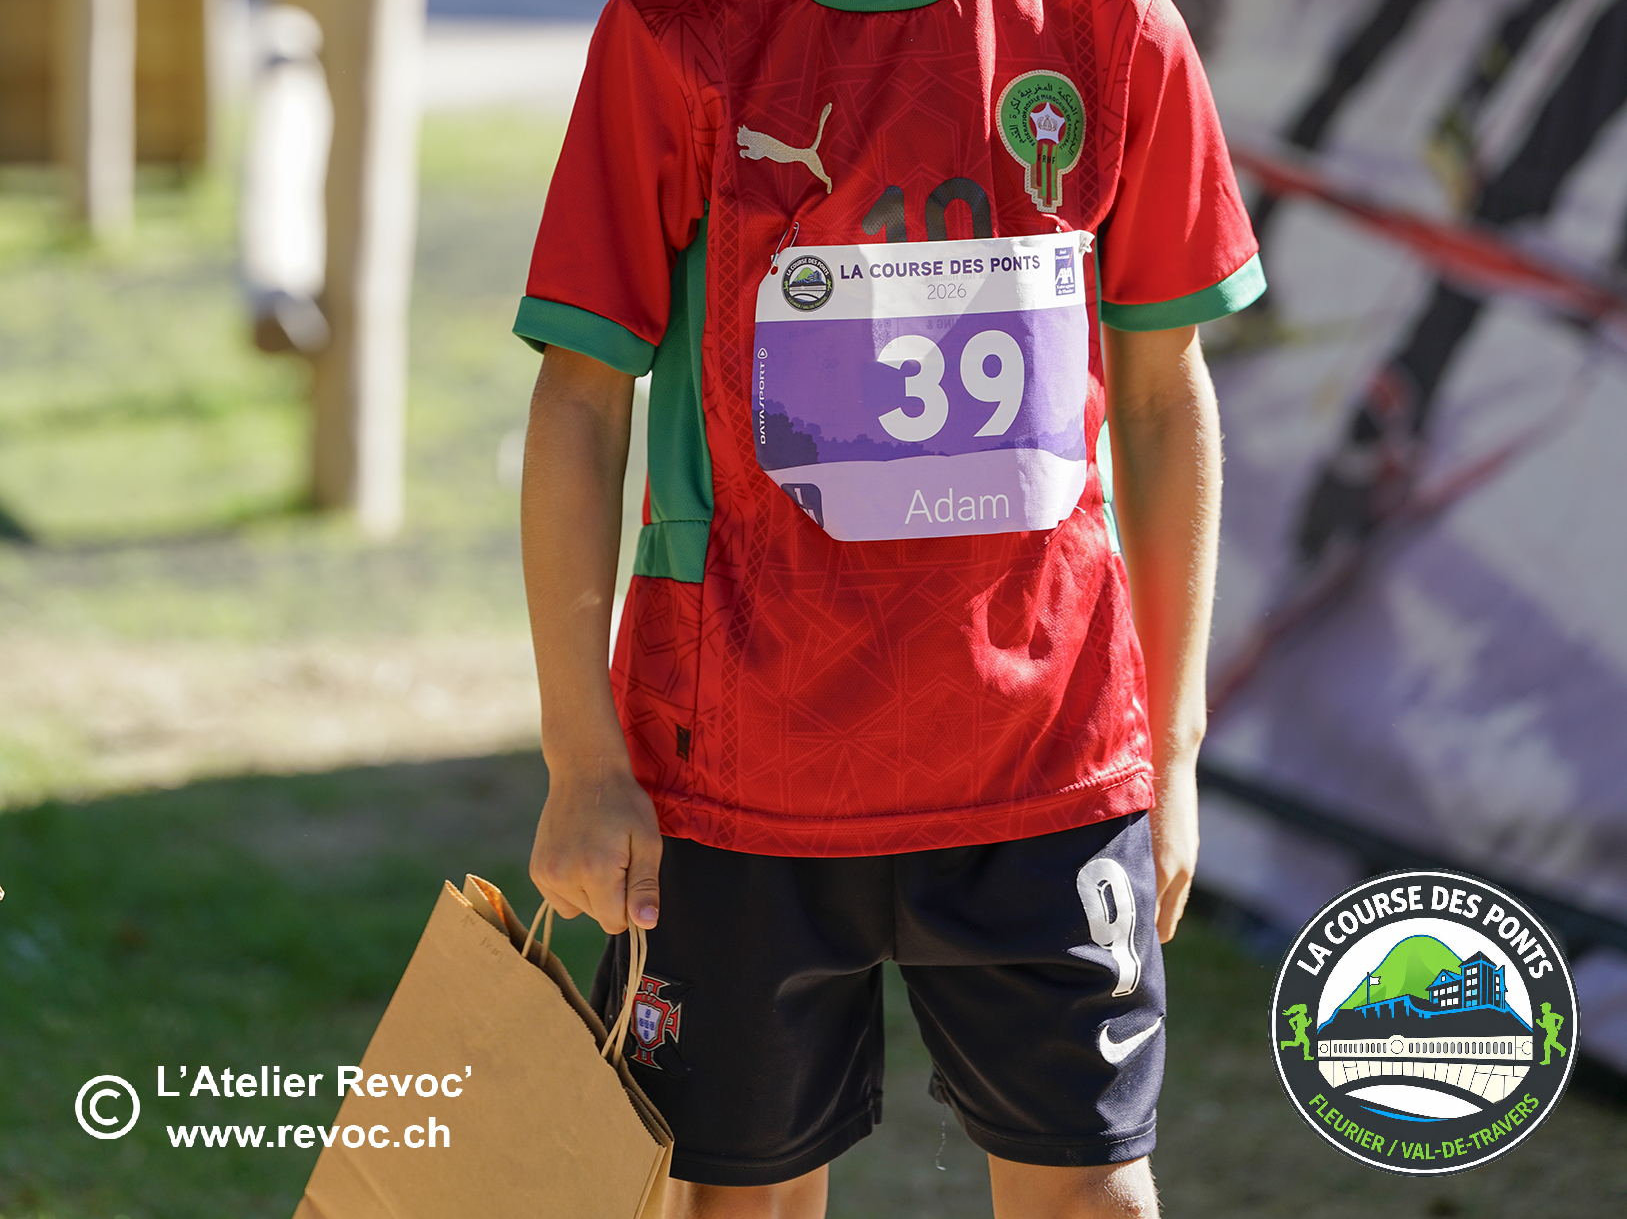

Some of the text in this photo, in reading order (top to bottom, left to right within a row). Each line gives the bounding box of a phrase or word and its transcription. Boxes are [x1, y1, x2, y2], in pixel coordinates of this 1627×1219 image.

[840, 255, 1041, 280] LA COURSE DES PONTS
[927, 283, 967, 300] 2026
[758, 361, 766, 445] DATASPORT
[877, 329, 1025, 442] 39
[904, 487, 1010, 525] Adam
[1076, 858, 1141, 997] 9
